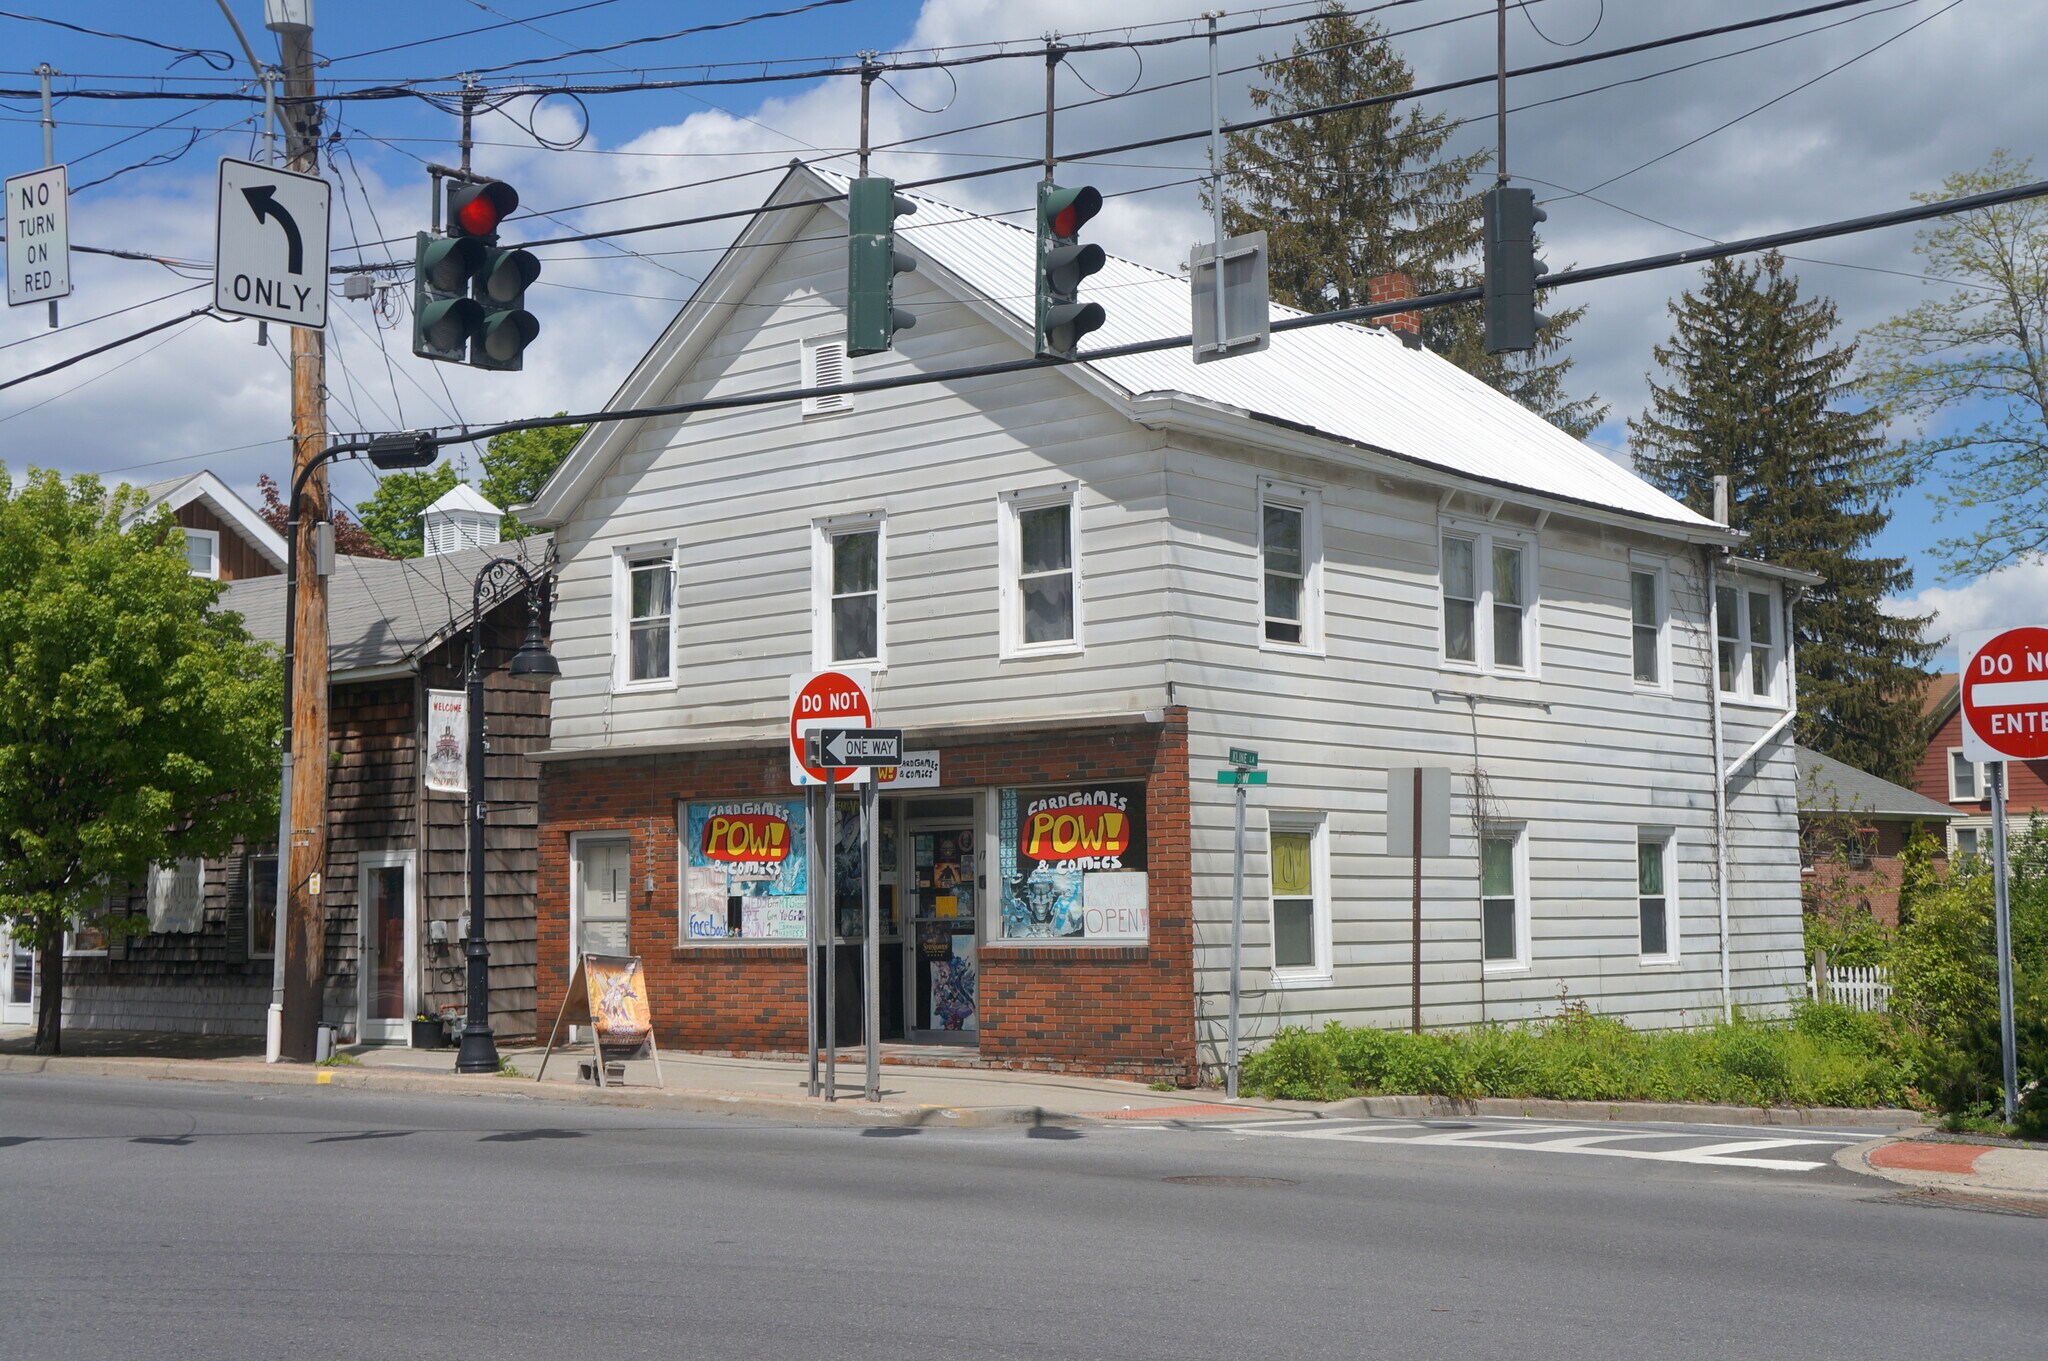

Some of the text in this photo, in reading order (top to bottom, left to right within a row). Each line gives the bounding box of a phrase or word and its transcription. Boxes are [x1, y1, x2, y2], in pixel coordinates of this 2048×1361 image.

[22, 182, 49, 211] NO
[19, 213, 55, 239] TURN
[27, 243, 48, 265] ON
[25, 270, 52, 293] RED
[233, 273, 312, 313] ONLY
[1980, 653, 2013, 676] DO
[433, 702, 462, 713] WELCOME
[801, 691, 860, 713] DO NOT
[846, 740, 894, 755] ONE WAY
[899, 770, 904, 778] &
[901, 758, 939, 772] ARDGAMES
[706, 817, 786, 857] POW!
[1028, 812, 1124, 855] POW!
[713, 859, 728, 874] &
[1037, 859, 1050, 873] &
[1086, 908, 1148, 933] OPEN!
